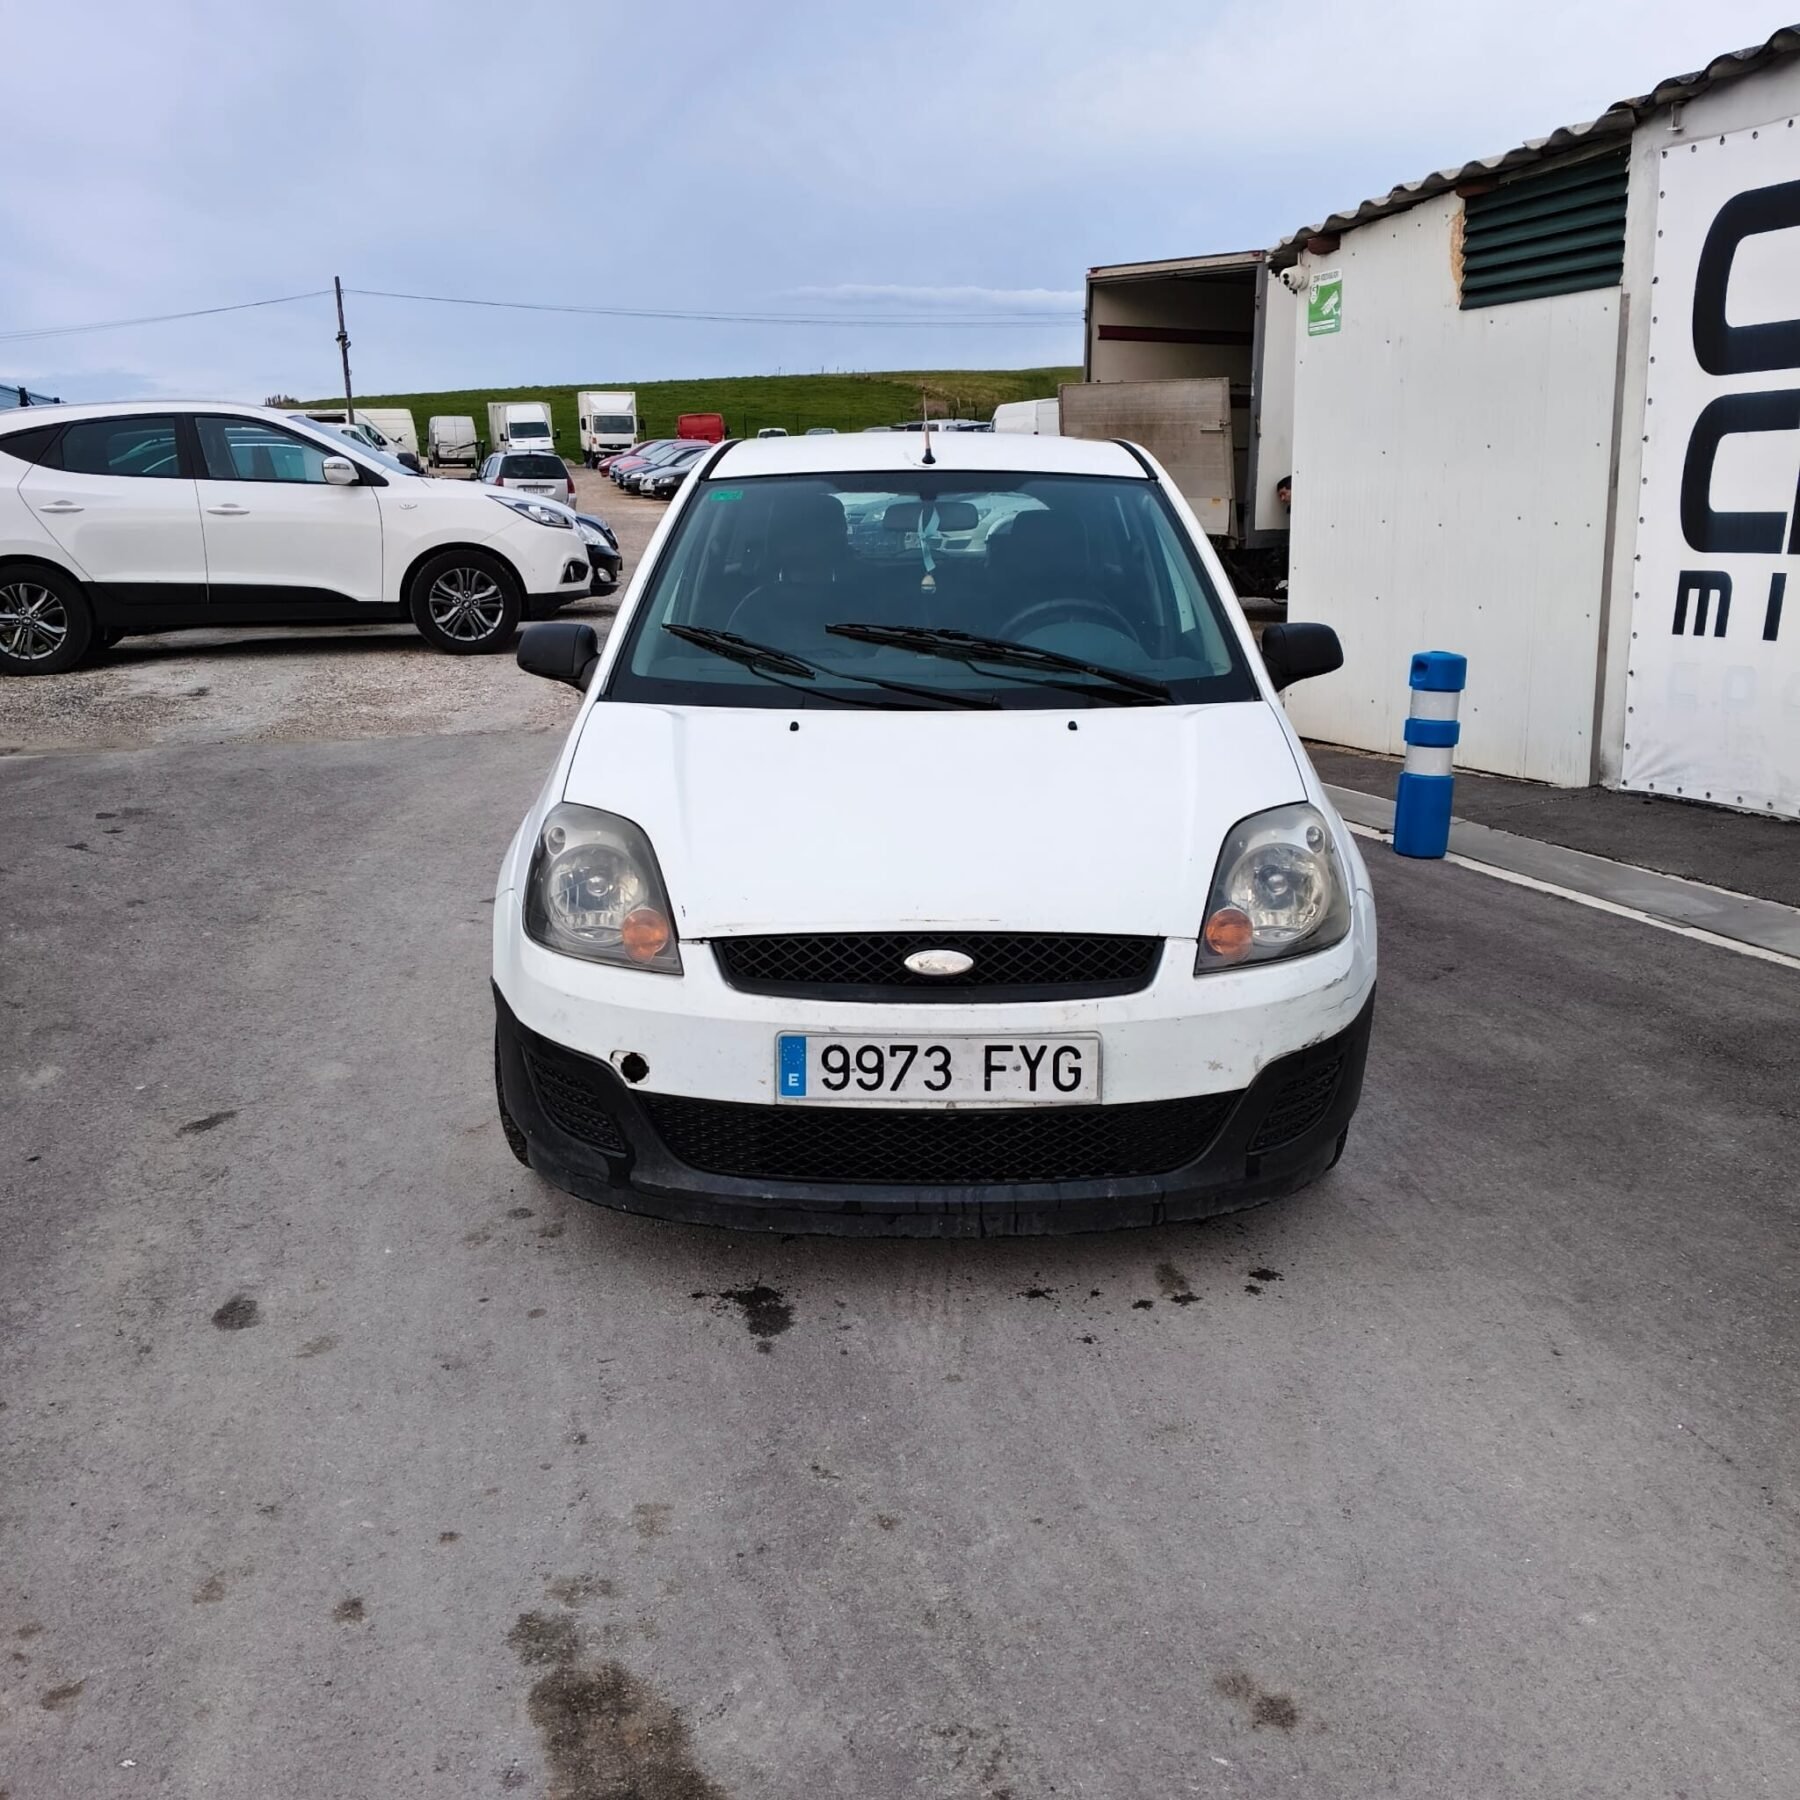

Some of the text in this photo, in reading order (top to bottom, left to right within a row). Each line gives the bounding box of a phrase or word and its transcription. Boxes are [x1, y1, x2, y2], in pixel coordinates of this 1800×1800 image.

[788, 1073, 800, 1086] E
[821, 1044, 1082, 1092] 9973 FYG
